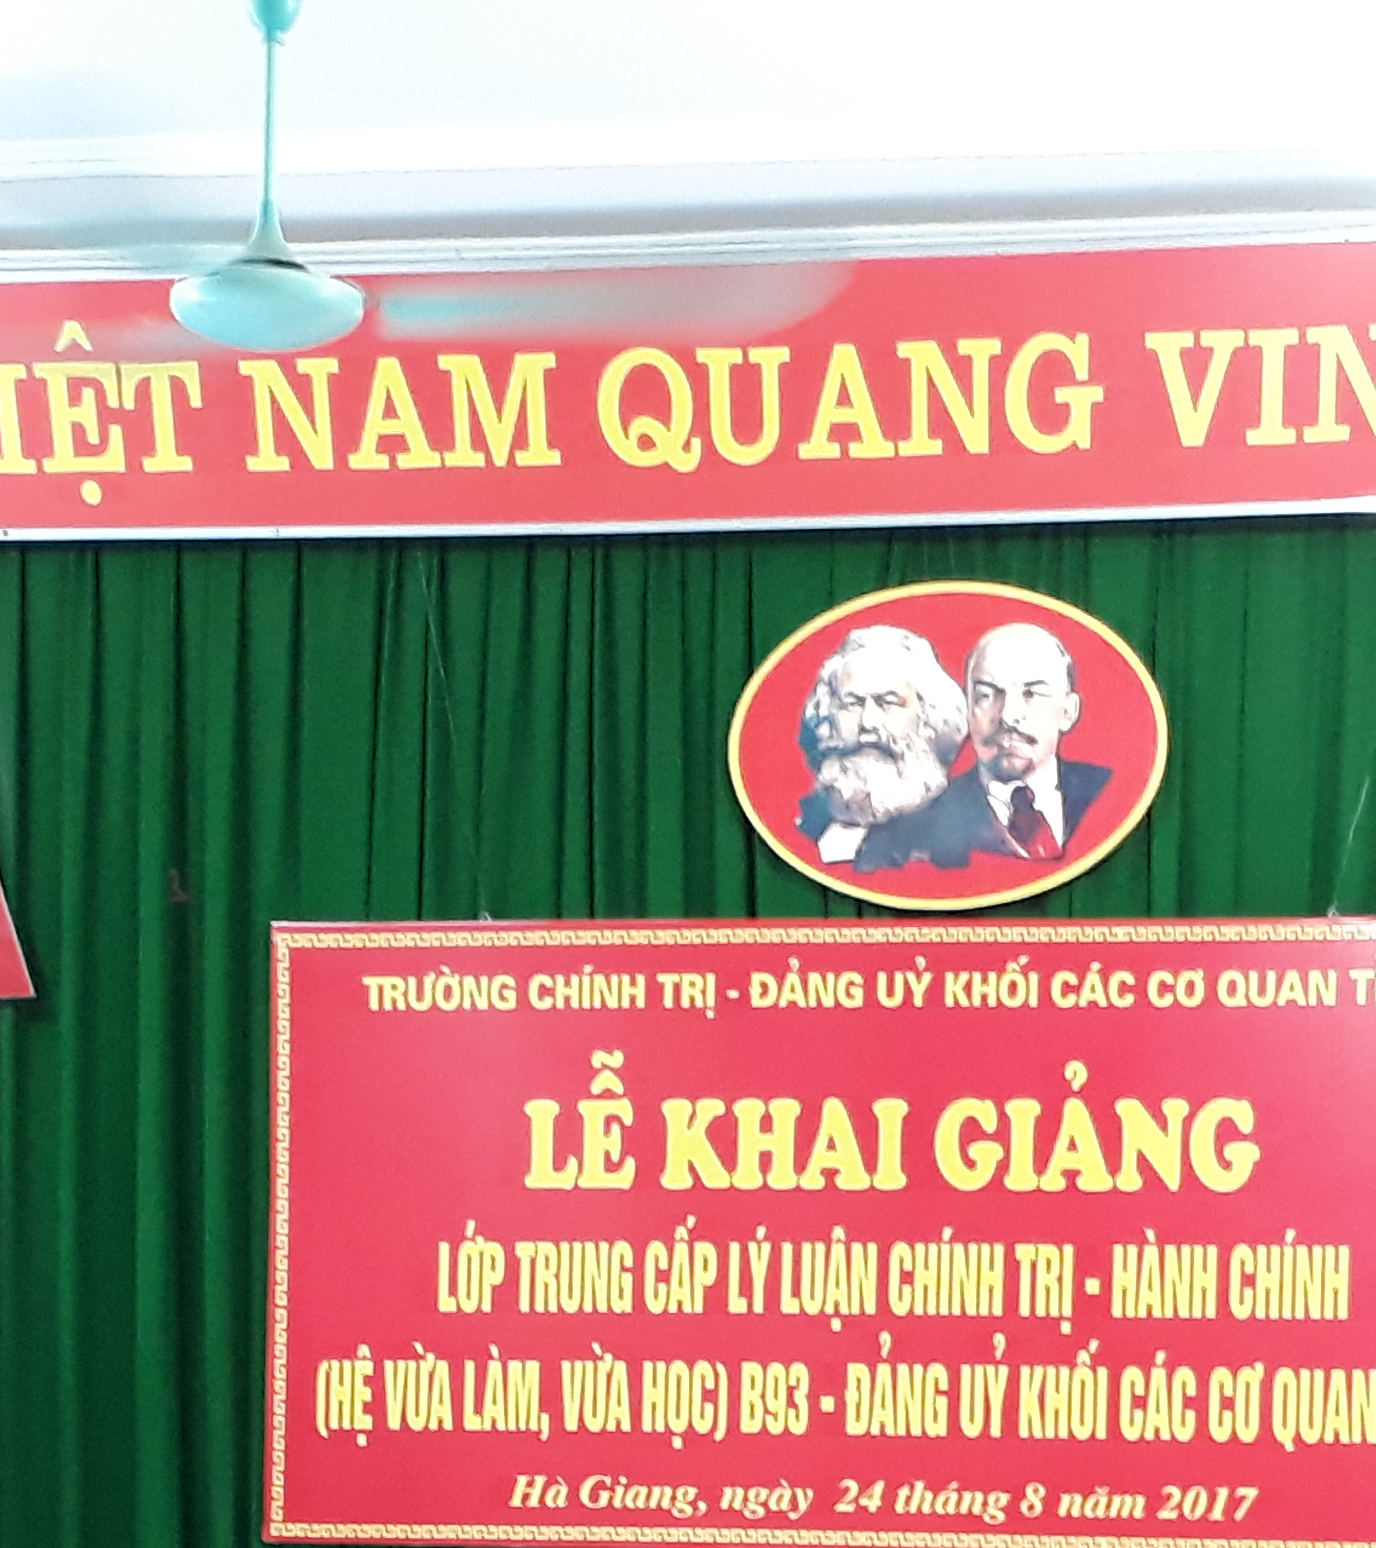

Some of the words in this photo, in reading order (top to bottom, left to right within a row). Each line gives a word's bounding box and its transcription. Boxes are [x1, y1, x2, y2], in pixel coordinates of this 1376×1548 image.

[239, 351, 561, 473] NAM
[596, 331, 1105, 473] QUANG
[361, 966, 517, 1012] TRƯỜNG
[527, 966, 646, 1010] CHÍNH
[656, 972, 717, 1019] TRỊ
[748, 956, 865, 1009] ĐẢNG
[876, 955, 934, 1009] UỶ
[944, 954, 1041, 1009] KHỐI
[1050, 964, 1136, 1009] CÁC
[1147, 967, 1206, 1008] CƠ
[1216, 968, 1339, 1008] QUAN
[523, 1049, 636, 1191] LỄ
[659, 1096, 910, 1191] KHAI
[933, 1059, 1261, 1193] GIẢNG
[437, 1219, 506, 1314] LỚP
[514, 1239, 634, 1314] TRUNG
[643, 1214, 718, 1315] CẤP
[727, 1225, 772, 1315] LÝ
[780, 1226, 878, 1331] LUẬN
[887, 1226, 1005, 1317] CHÍNH
[1014, 1242, 1075, 1334] TRỊ
[1110, 1227, 1219, 1320] HÀNH
[1228, 1228, 1351, 1321] CHÍNH
[315, 1343, 375, 1444] (HỆ
[383, 1341, 454, 1432] VỪA
[462, 1343, 550, 1442] LÀM,
[560, 1341, 632, 1433] VỪA
[641, 1359, 729, 1450] HỌC)
[739, 1361, 810, 1436] B93
[844, 1330, 950, 1438] ĐẢNG
[959, 1332, 1010, 1439] UỶ
[1018, 1338, 1109, 1441] KHỐI
[1119, 1349, 1198, 1443] CÁC
[1208, 1361, 1265, 1444] CƠ
[508, 1474, 569, 1509] Hà
[578, 1474, 708, 1519] Giang,
[719, 1478, 815, 1521] ngày
[833, 1478, 886, 1514] 24
[893, 1479, 1011, 1525] tháng
[1019, 1481, 1047, 1518] 8
[1057, 1485, 1147, 1520] năm
[1155, 1484, 1260, 1522] 2017
